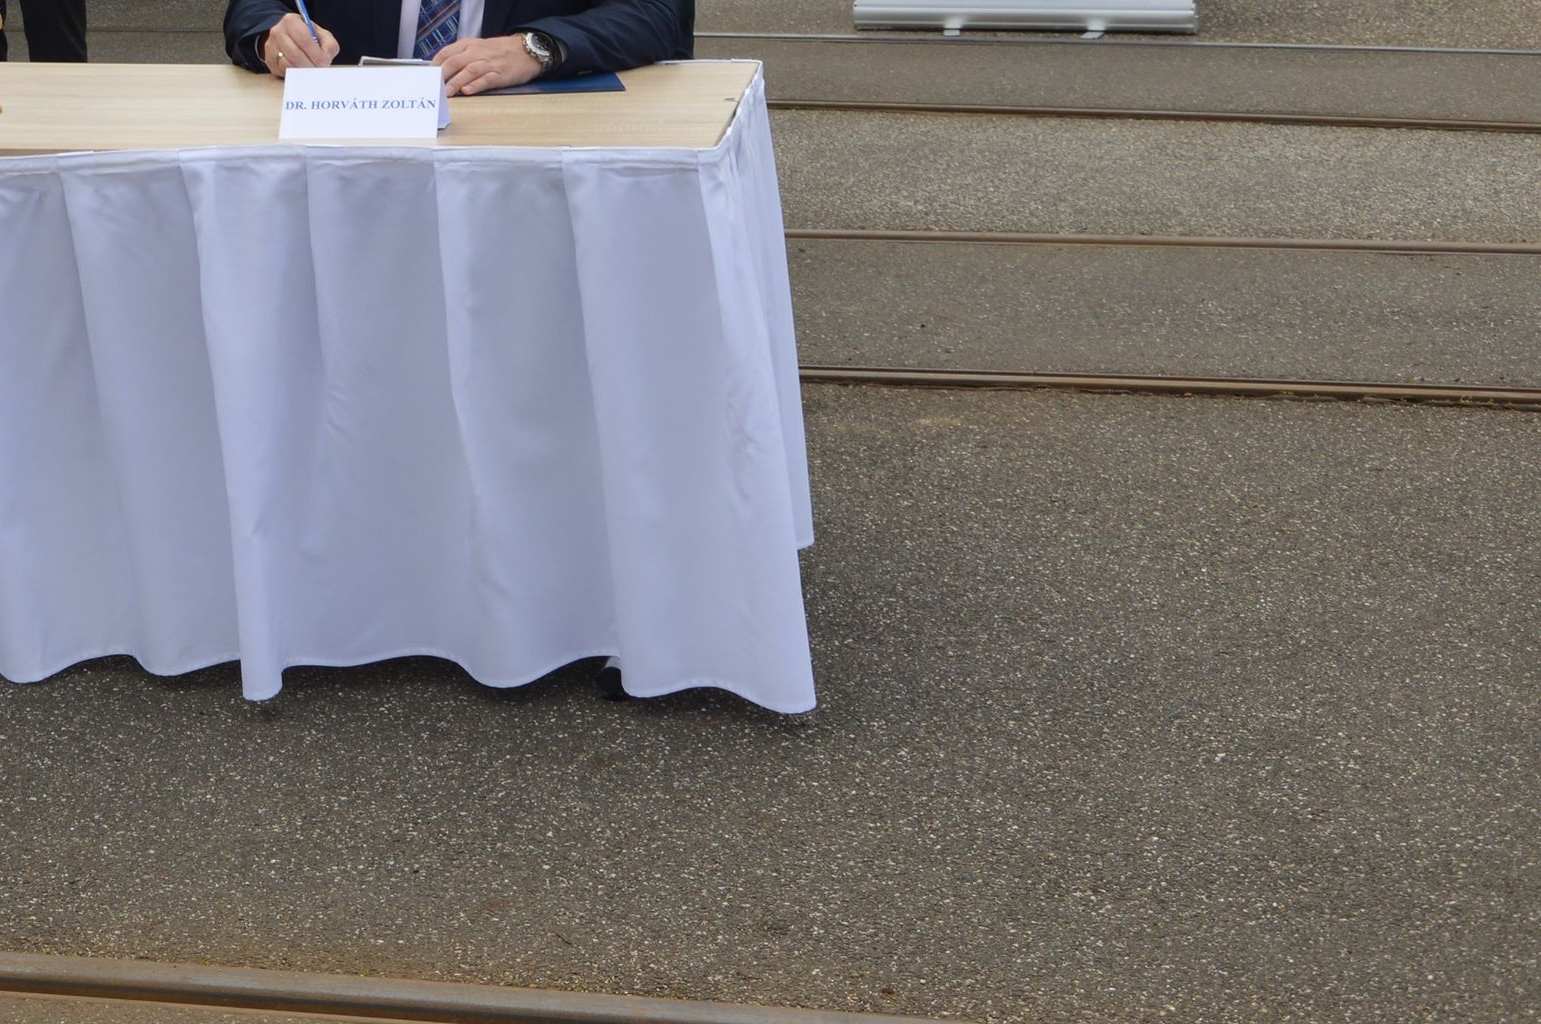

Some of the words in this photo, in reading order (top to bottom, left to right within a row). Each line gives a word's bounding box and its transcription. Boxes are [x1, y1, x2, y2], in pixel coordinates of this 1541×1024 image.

[285, 101, 307, 110] DR.
[311, 97, 378, 110] HORVÁTH
[380, 96, 437, 109] ZOLTÁN
